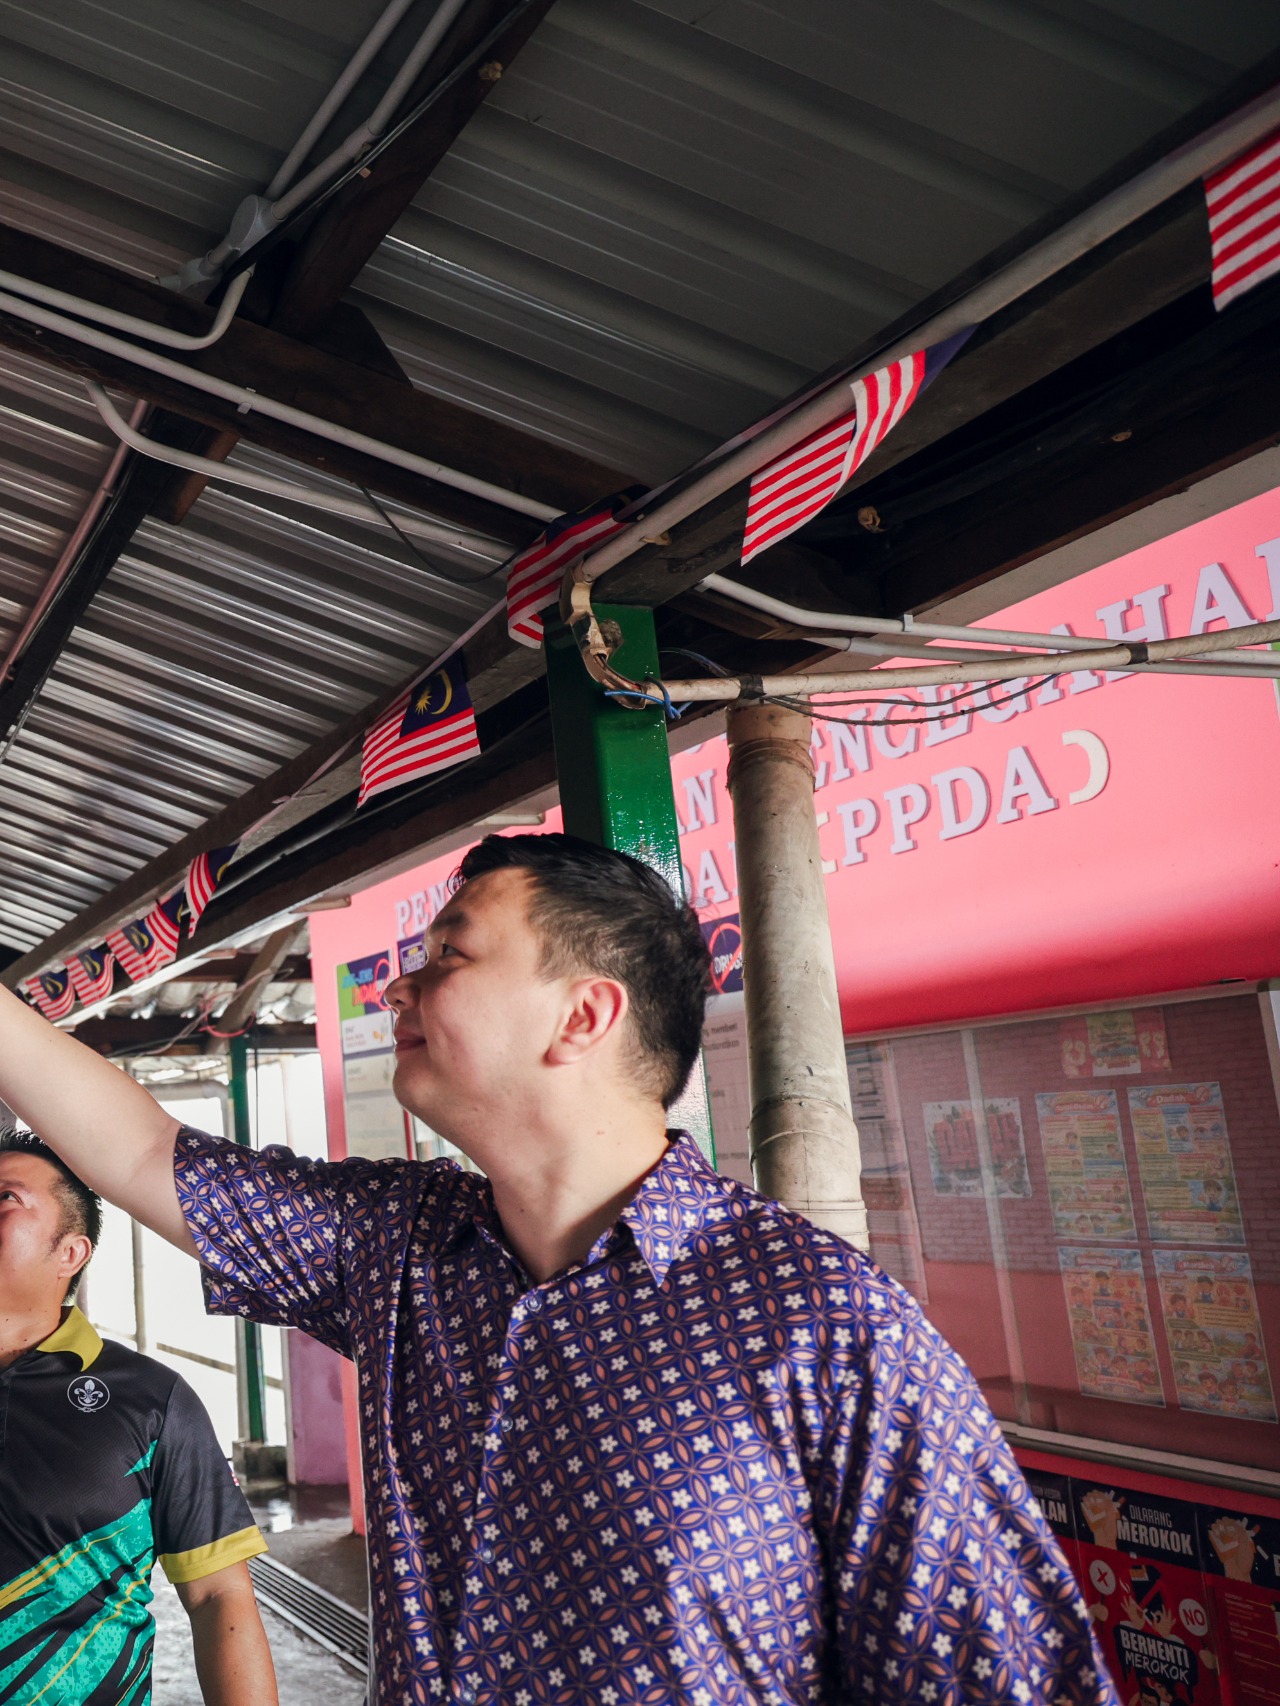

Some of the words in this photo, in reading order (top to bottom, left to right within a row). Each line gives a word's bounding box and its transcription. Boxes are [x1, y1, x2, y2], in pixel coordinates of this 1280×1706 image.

[1129, 1505, 1172, 1528] DILARANG
[1117, 1519, 1193, 1556] MEROKOK
[1183, 1609, 1205, 1629] NO
[1121, 1629, 1190, 1668] BERHENTI
[1125, 1651, 1189, 1684] MEROKOK
